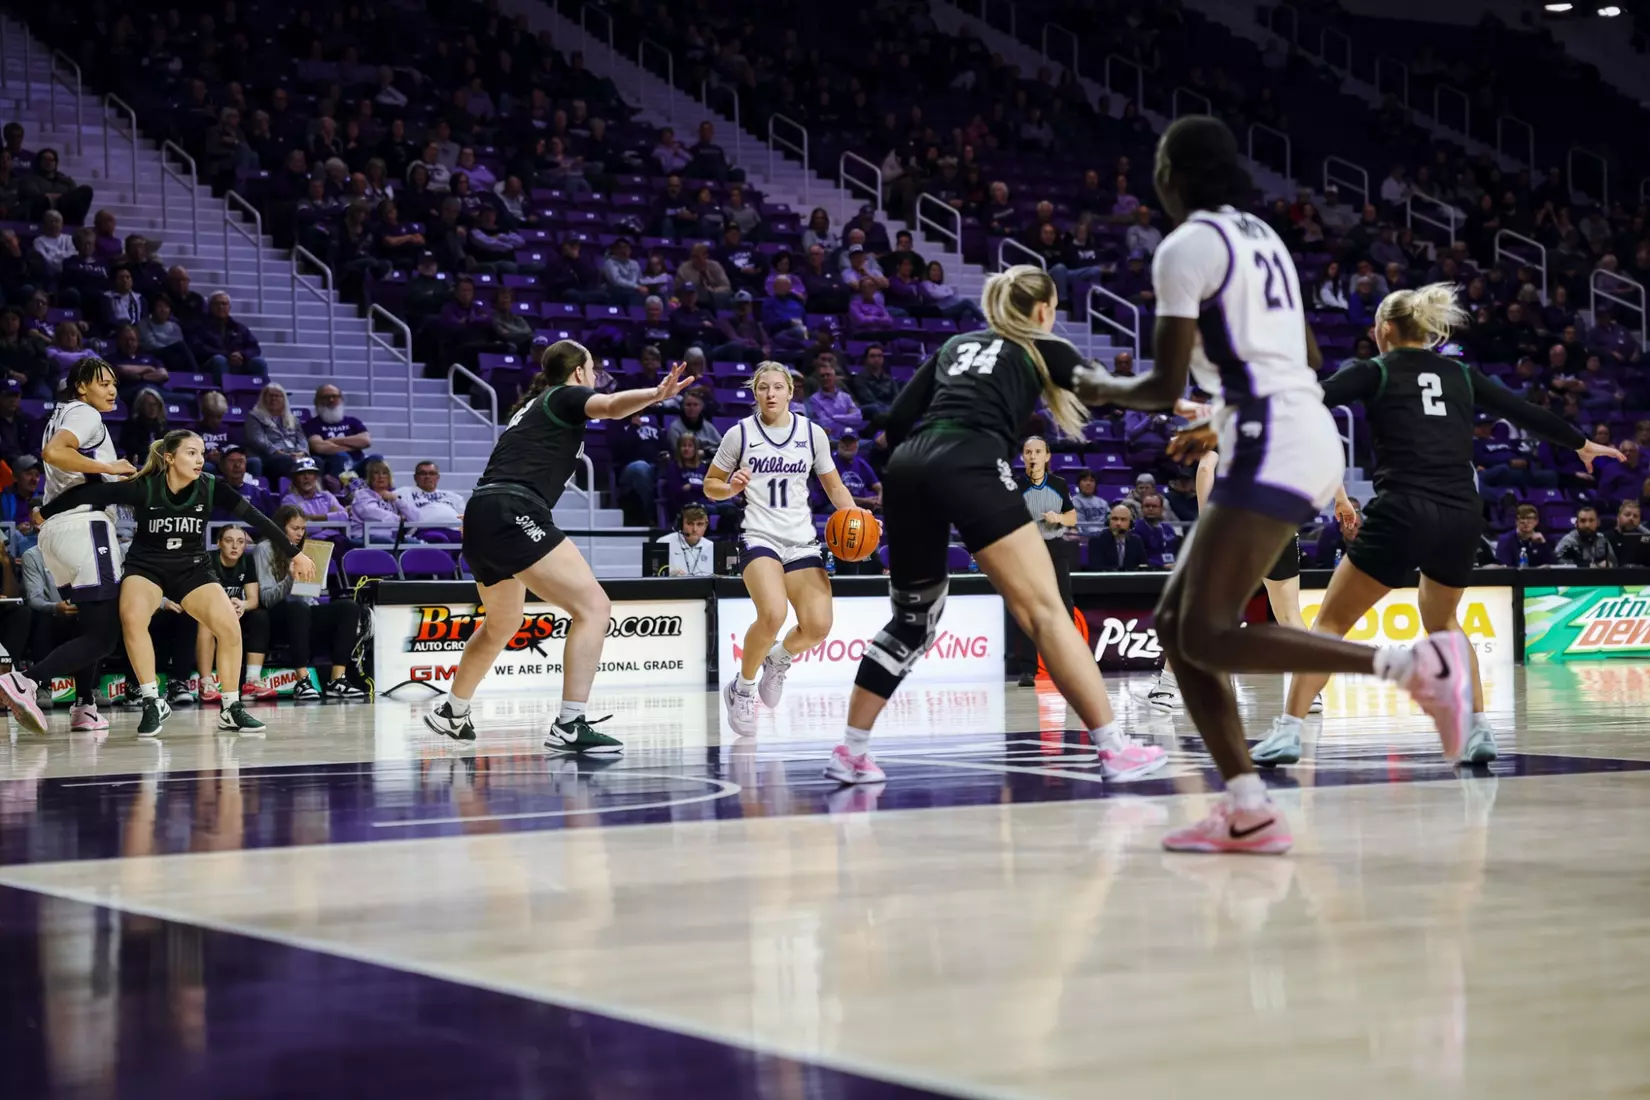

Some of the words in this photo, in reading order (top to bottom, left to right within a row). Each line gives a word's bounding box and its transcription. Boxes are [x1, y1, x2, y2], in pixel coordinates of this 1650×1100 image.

[1254, 250, 1293, 310] 21
[947, 339, 1004, 376] 34
[1417, 372, 1447, 416] 2
[749, 456, 807, 474] Wildcats
[767, 478, 789, 508] 11
[149, 516, 203, 534] UPSTATE
[414, 641, 443, 651] AUTO
[444, 640, 466, 651] GRO
[410, 665, 459, 681] GM
[494, 665, 514, 675] WE
[518, 664, 542, 675] ARE
[547, 661, 640, 674] PRSIONAL
[643, 660, 684, 670] GRADE
